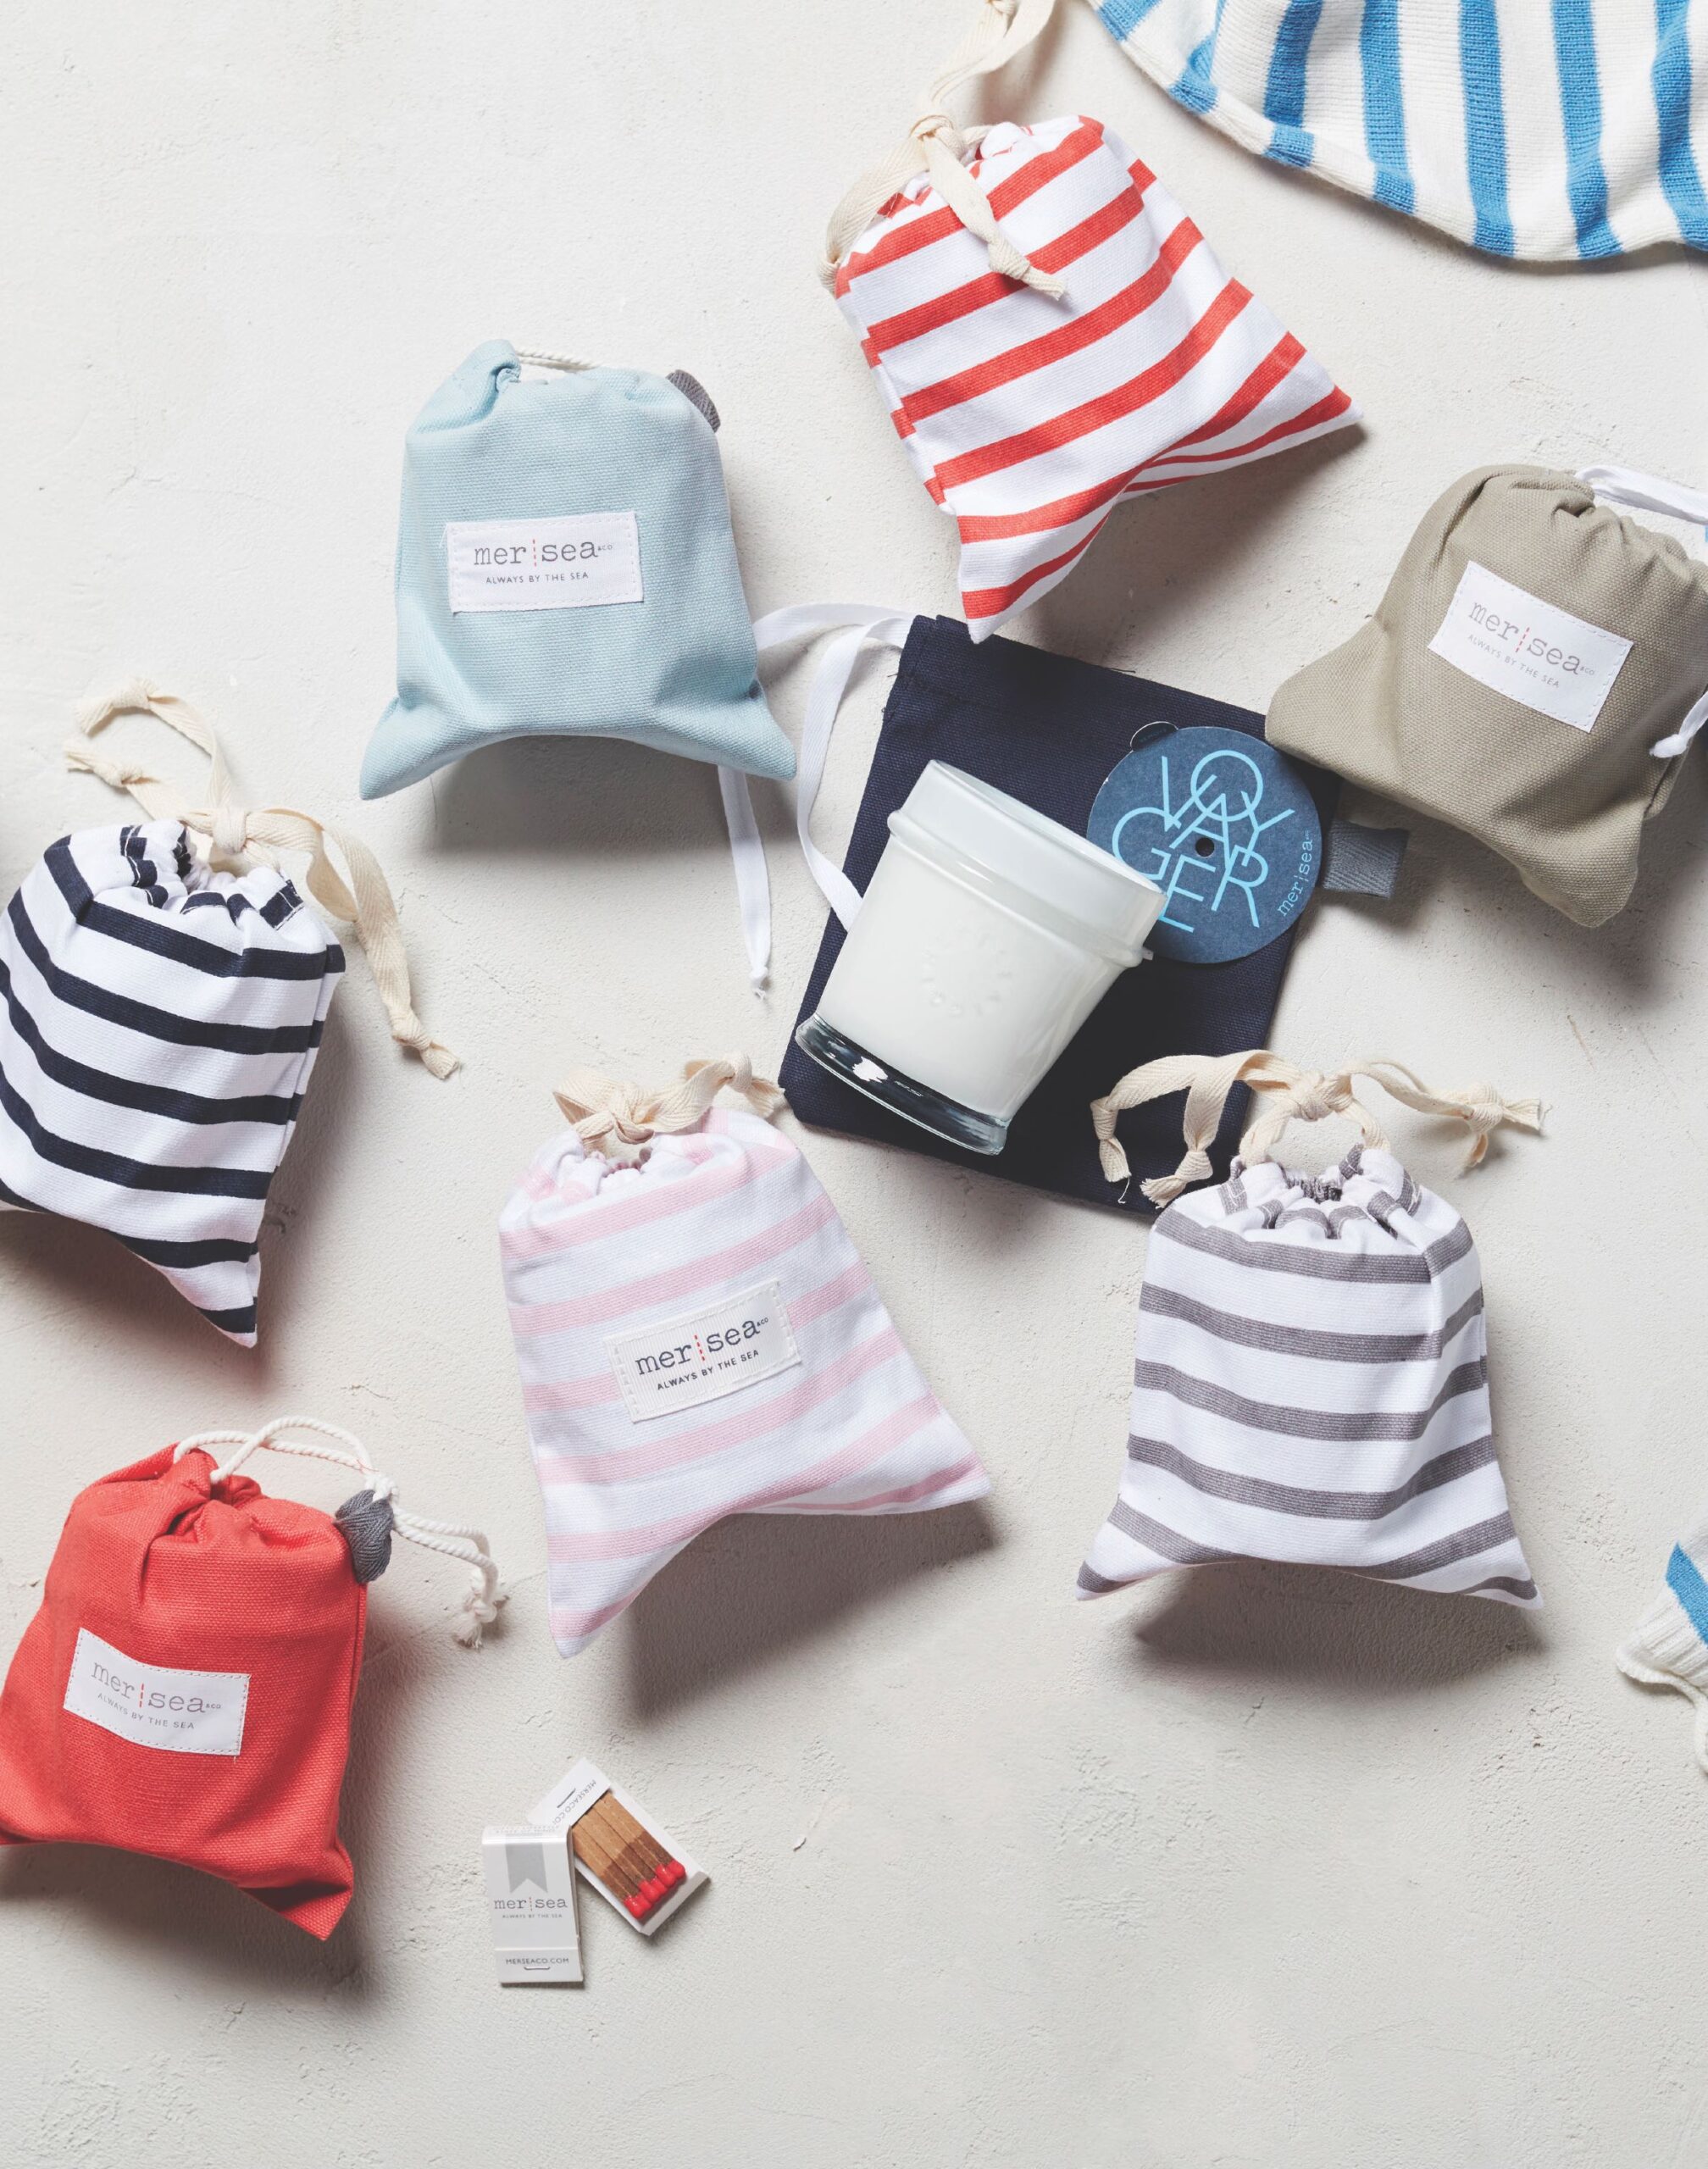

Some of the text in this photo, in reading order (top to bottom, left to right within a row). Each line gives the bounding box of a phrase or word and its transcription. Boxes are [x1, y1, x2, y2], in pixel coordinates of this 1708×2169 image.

[485, 571, 589, 585] ALWAYS BY THE SEA
[1467, 634, 1560, 689] ALWAYS BY THE SEA
[657, 1349, 759, 1390] ALWAYS BY THE SEA
[97, 1693, 195, 1730] ALWAYS BY THE SEA
